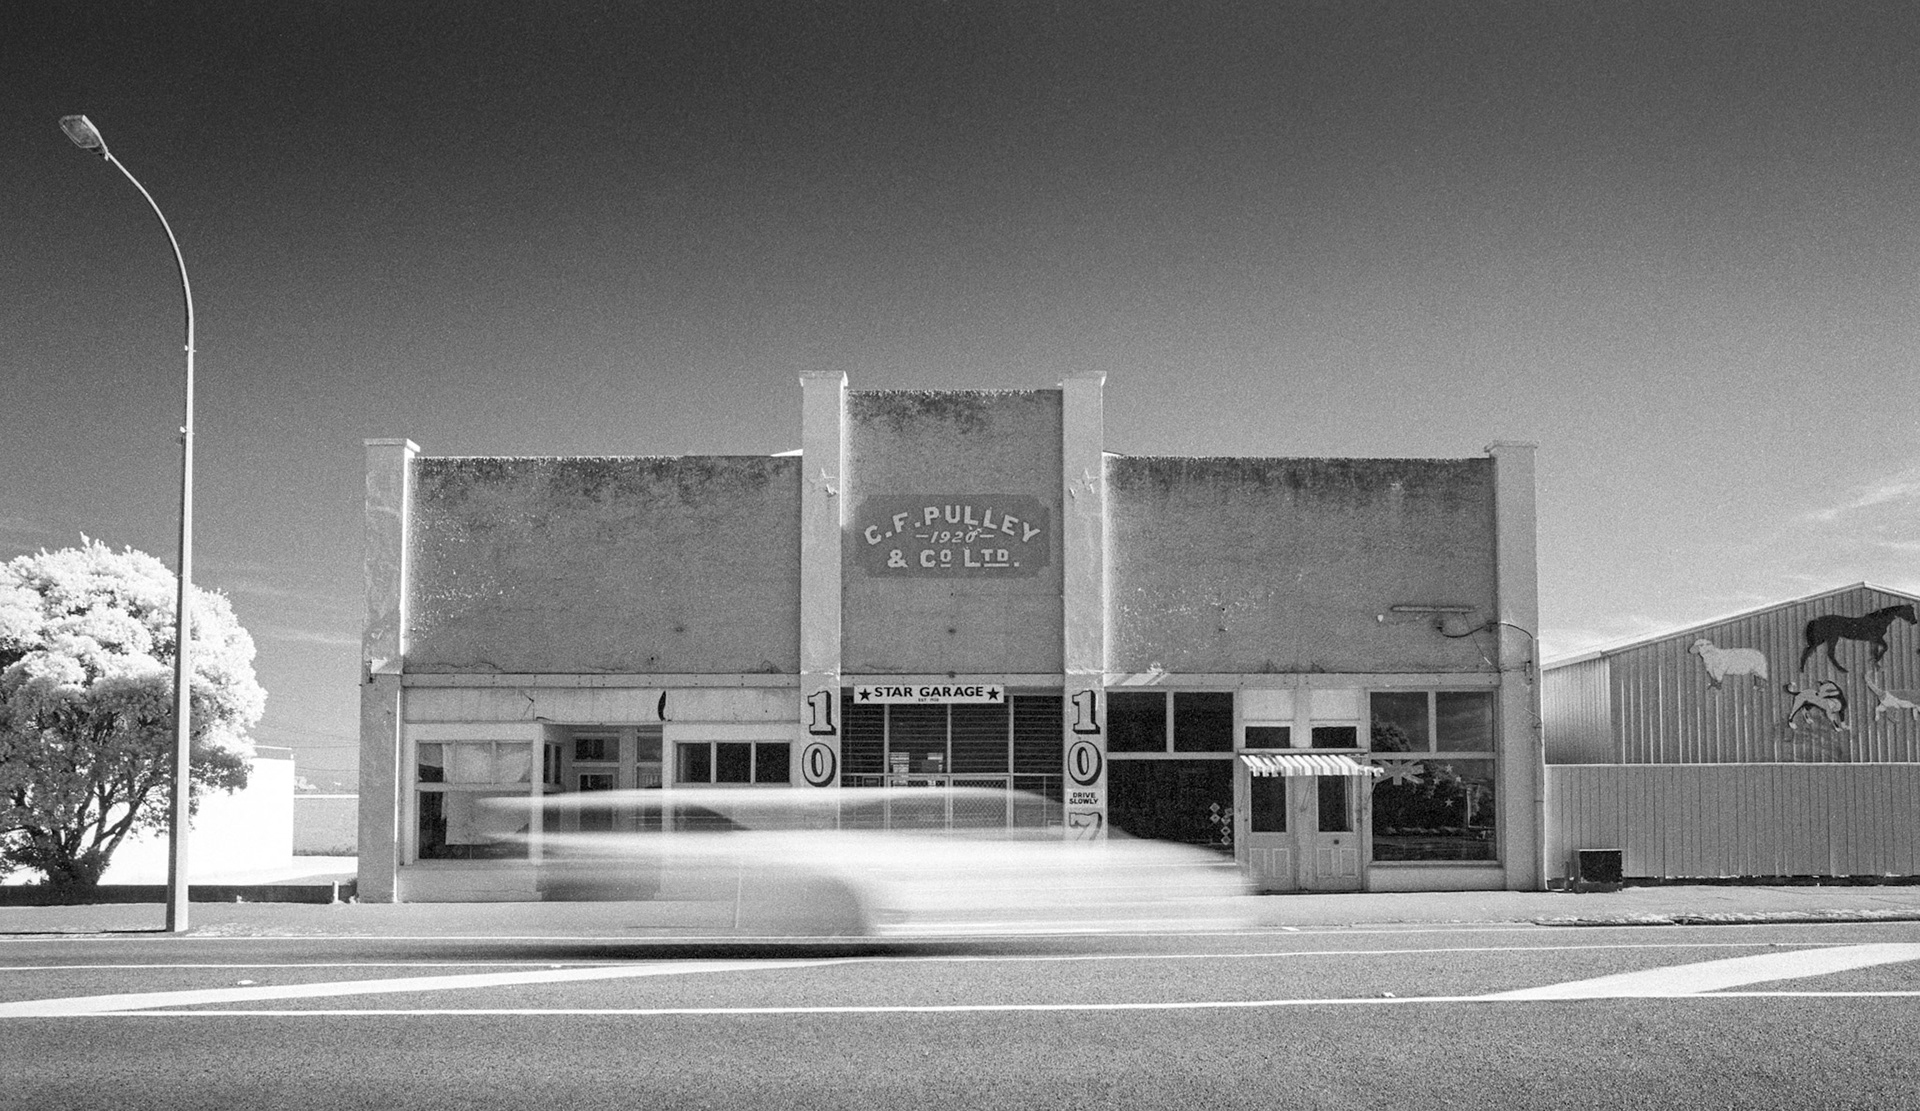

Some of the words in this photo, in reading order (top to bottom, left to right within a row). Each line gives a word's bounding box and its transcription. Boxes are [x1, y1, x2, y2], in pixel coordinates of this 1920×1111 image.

[887, 549, 909, 568] &
[874, 686, 913, 697] STAR
[919, 686, 984, 697] GARAGE
